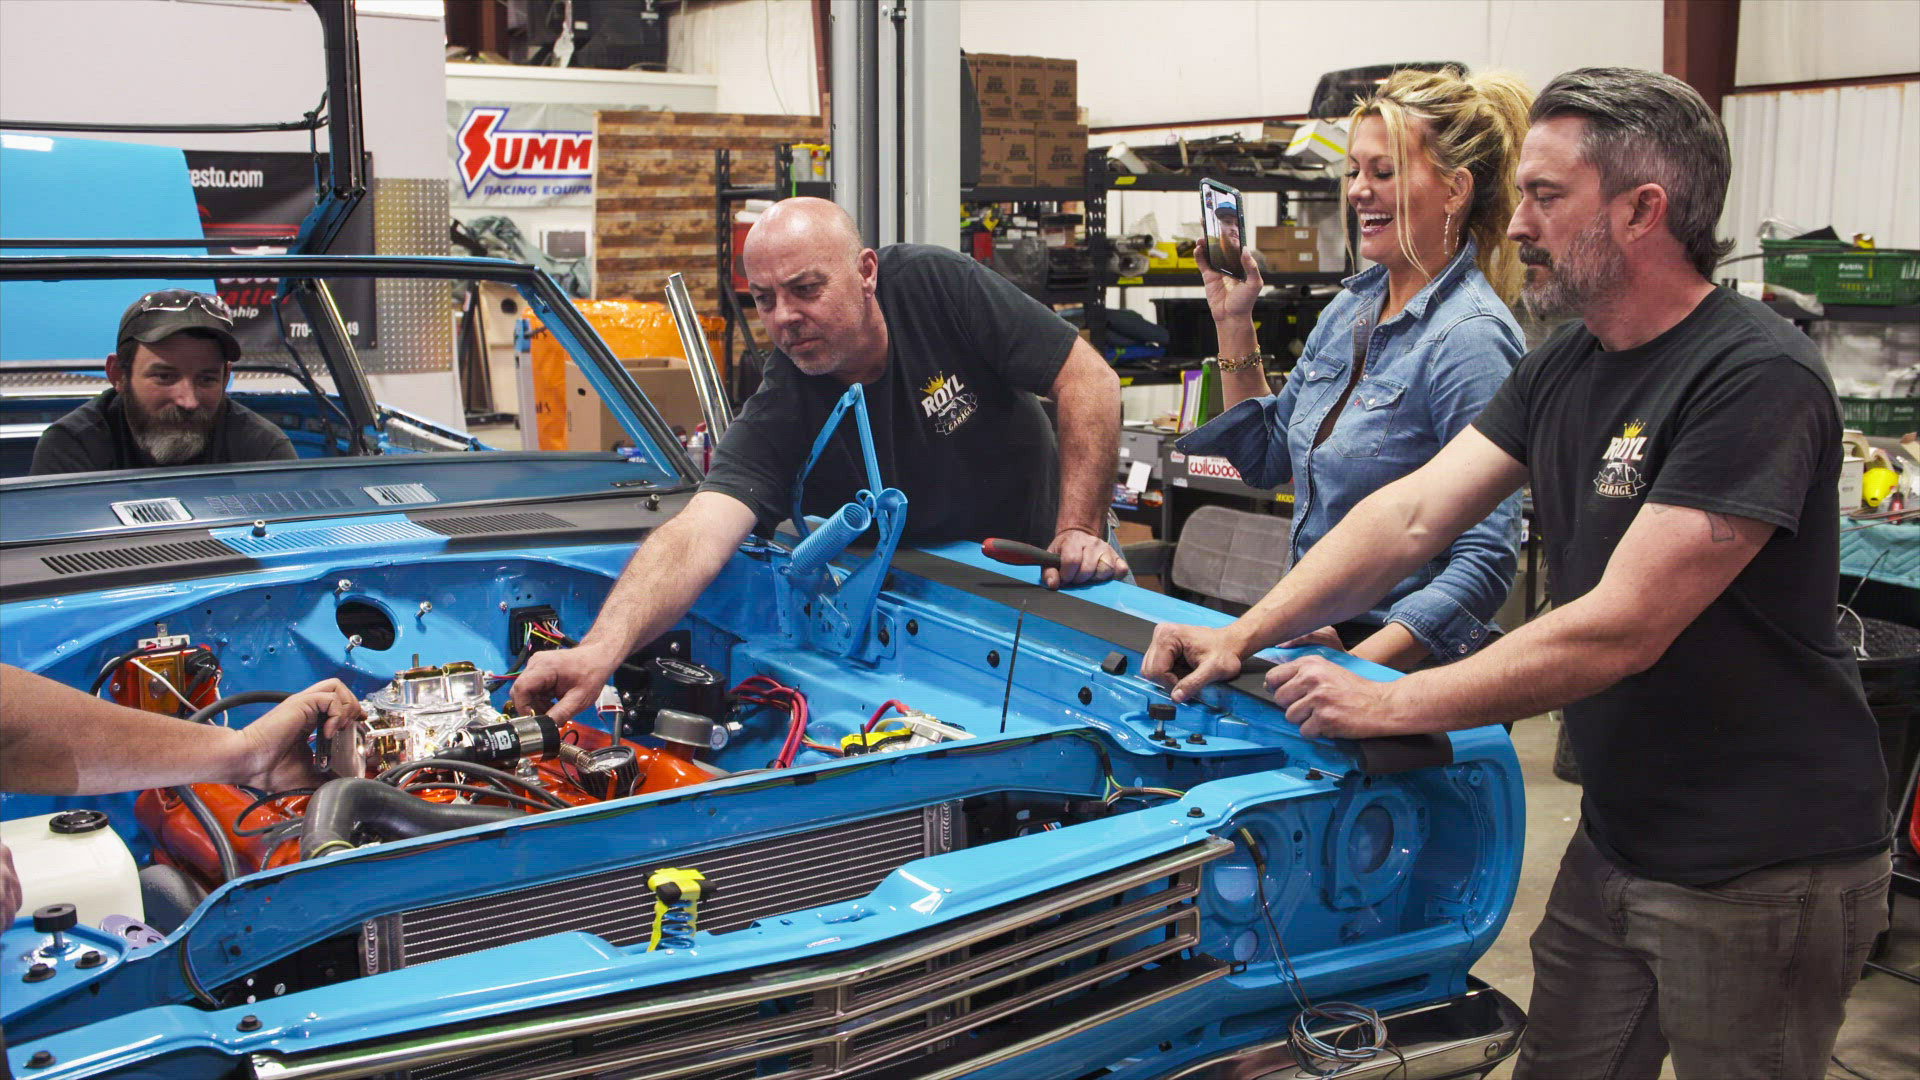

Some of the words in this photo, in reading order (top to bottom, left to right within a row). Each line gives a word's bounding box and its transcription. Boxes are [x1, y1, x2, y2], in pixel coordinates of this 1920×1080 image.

[189, 166, 264, 188] esto.com
[484, 185, 537, 195] RACING
[921, 374, 965, 418] ROYL
[948, 404, 974, 431] GARAGE
[1602, 436, 1648, 461] ROYL
[1598, 483, 1632, 496] GARAGE
